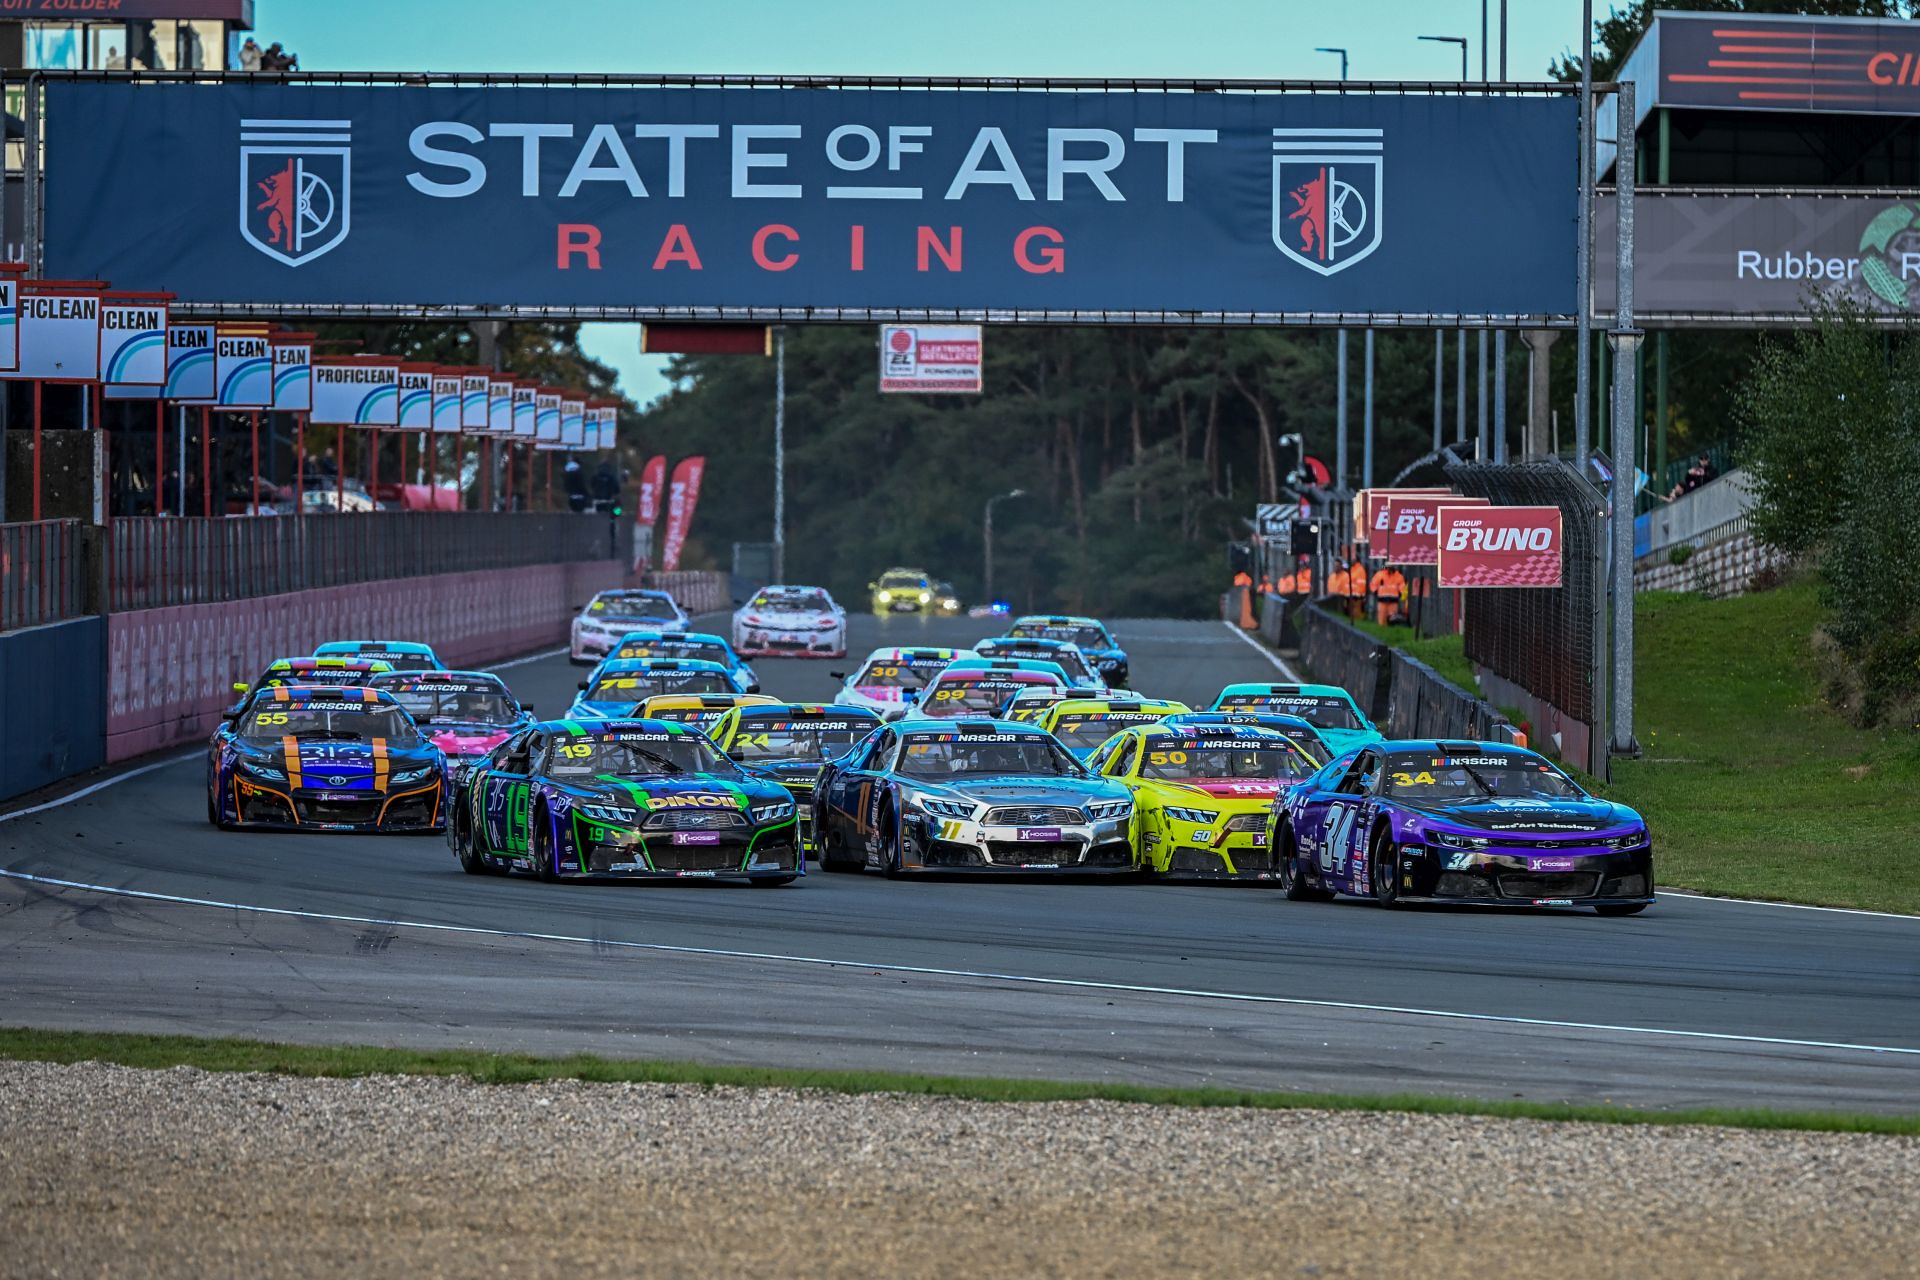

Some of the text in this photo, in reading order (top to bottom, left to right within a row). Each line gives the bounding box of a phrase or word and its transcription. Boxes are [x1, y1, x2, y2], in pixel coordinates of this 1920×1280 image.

[405, 121, 1219, 203] STATE OF ART
[556, 223, 1066, 274] RACING
[1737, 250, 1860, 280] Rubber
[20, 296, 96, 319] FICLEAN
[170, 330, 208, 348] LEAN
[218, 340, 266, 358] CLEAN
[316, 368, 395, 384] PROFICLEAN
[1453, 520, 1482, 528] GROUP
[1446, 527, 1552, 551] BRUNO
[357, 652, 404, 660] NASCAR
[312, 670, 362, 678] NASCAR
[647, 670, 696, 678] NASCAR
[871, 667, 899, 677] 30
[416, 684, 468, 692] NASCAR
[600, 678, 638, 690] 76
[935, 689, 966, 700] 99
[307, 702, 362, 711] NASCAR
[1268, 698, 1319, 706] NASCAR
[256, 712, 289, 725] 55
[1107, 713, 1162, 721] NASCAR
[791, 722, 848, 730] NASCAR
[1061, 723, 1082, 733] 7
[619, 734, 670, 742] NASCAR
[736, 733, 769, 747] 24
[957, 734, 1016, 742] NASCAR
[558, 744, 592, 759] 19
[1203, 741, 1261, 749] NASCAR
[1150, 751, 1188, 765] 50
[1450, 758, 1508, 766] NASCAR
[1391, 771, 1437, 787] 34
[241, 782, 255, 797] 55
[646, 795, 744, 810] DINOIL
[505, 781, 530, 854] 19
[588, 827, 605, 842] 19
[939, 820, 962, 840] 11
[1191, 829, 1212, 842] 50
[1320, 800, 1358, 876] 34
[1446, 852, 1475, 871] 34
